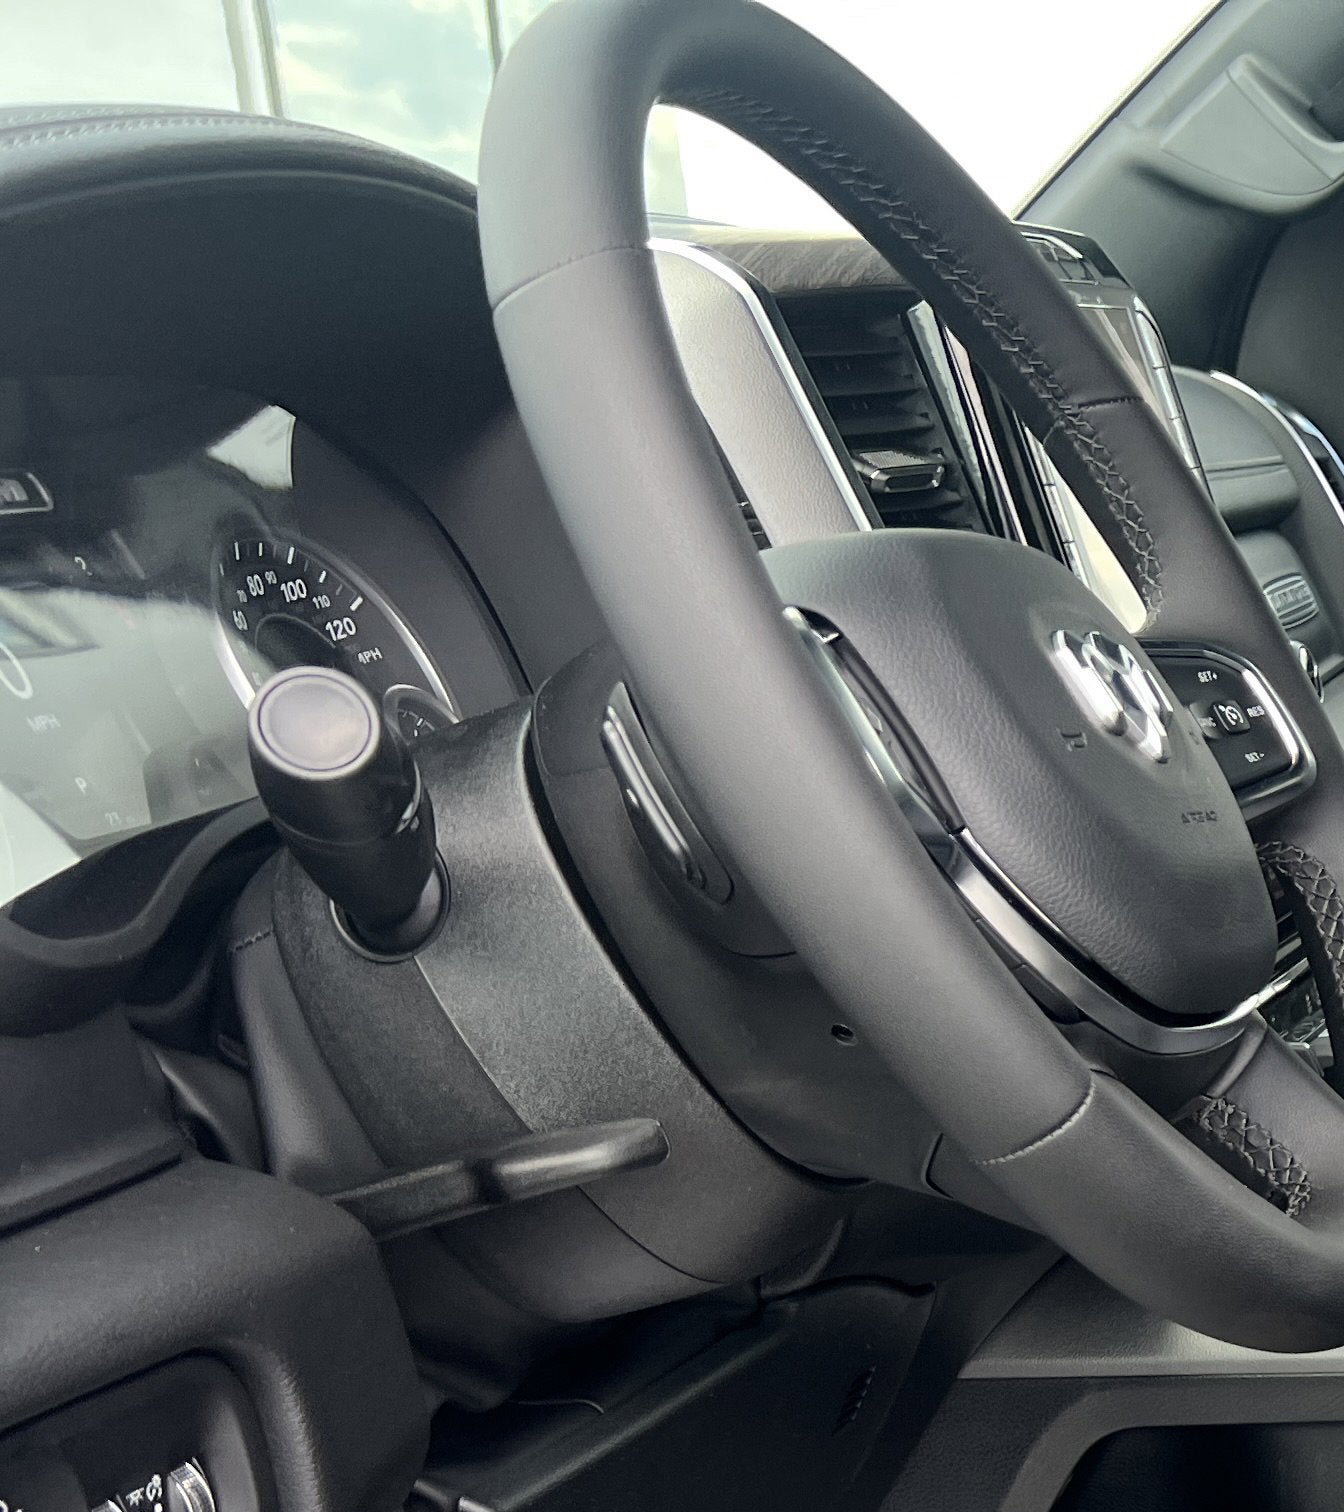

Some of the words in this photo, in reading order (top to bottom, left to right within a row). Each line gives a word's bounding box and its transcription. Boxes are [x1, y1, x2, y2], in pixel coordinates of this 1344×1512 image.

[246, 574, 265, 597] 80
[264, 570, 277, 585] 90
[280, 578, 307, 602] 100
[312, 594, 331, 609] 110
[325, 617, 357, 642] 120
